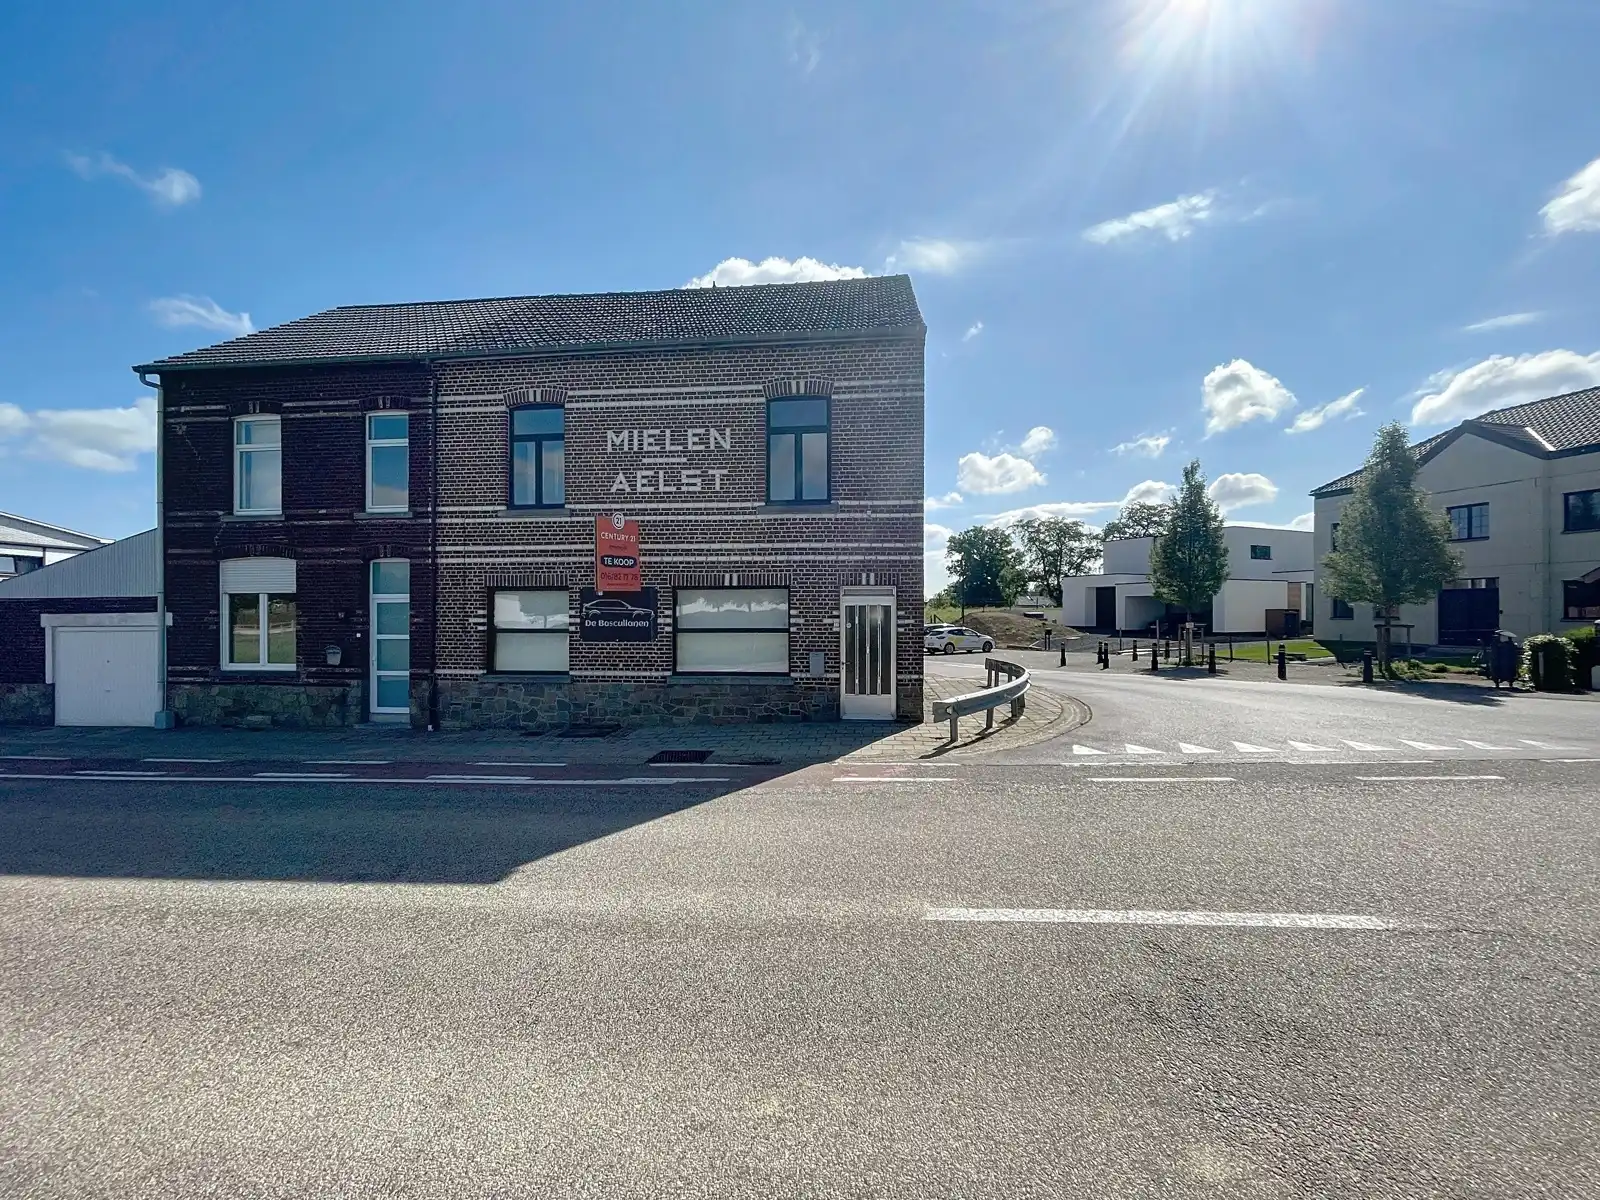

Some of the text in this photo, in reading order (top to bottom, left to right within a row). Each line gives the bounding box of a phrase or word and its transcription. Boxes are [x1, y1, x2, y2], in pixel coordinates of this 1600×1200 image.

[607, 428, 731, 451] MIELEN
[610, 470, 729, 491] AELST
[615, 517, 622, 525] 21
[601, 532, 629, 541] CENTURY
[604, 557, 634, 566] TE KOOP
